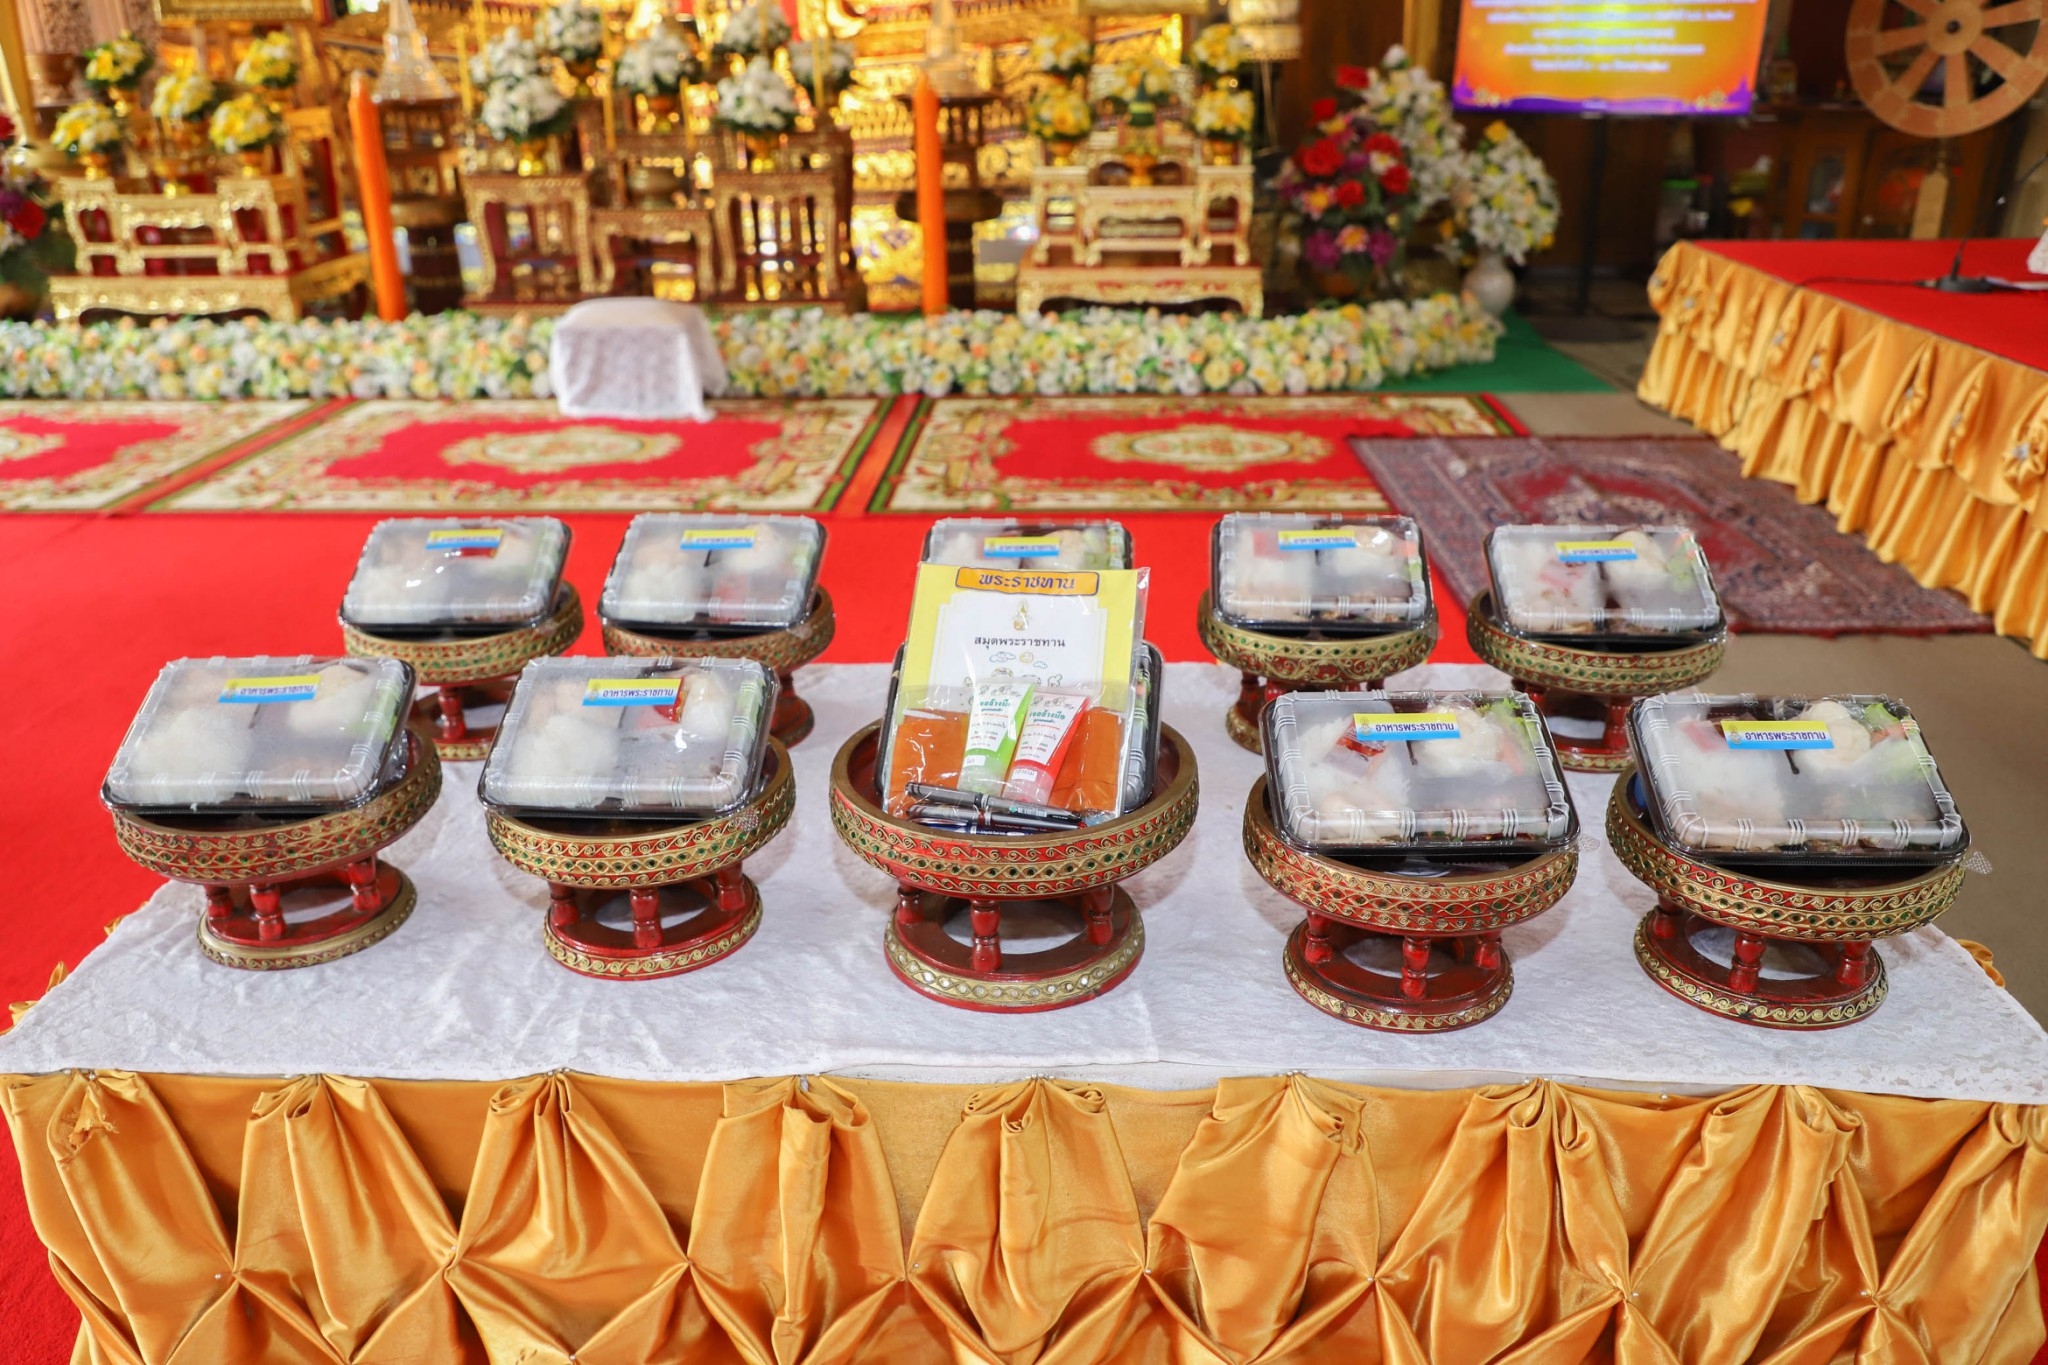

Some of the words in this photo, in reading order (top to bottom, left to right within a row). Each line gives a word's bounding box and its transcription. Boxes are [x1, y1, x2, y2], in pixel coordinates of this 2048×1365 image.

[978, 572, 1076, 590] พระราชทาน
[974, 636, 1066, 649] สมุดพระราชทาน
[240, 683, 315, 696] อาหารพระราชทาน
[602, 688, 674, 698] อาหารพระราชทาน
[1375, 722, 1455, 732] อาหารพระราชทาน
[1745, 730, 1827, 741] อาหารพระราชทาน
